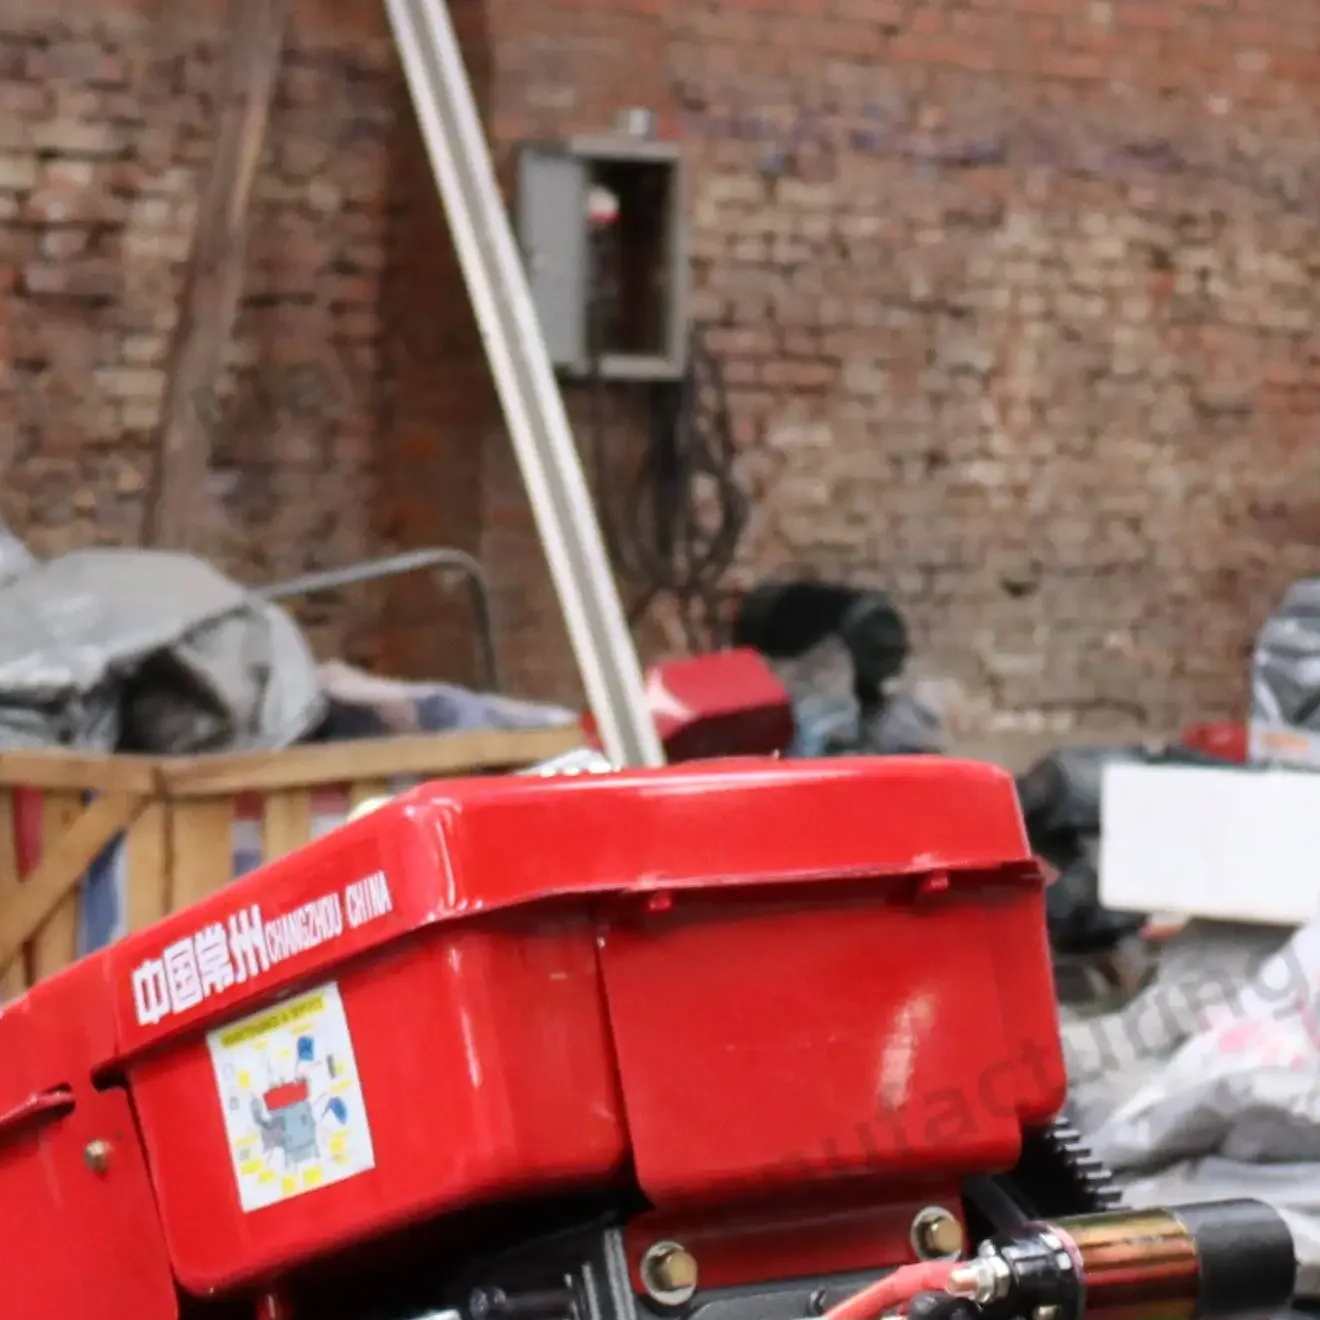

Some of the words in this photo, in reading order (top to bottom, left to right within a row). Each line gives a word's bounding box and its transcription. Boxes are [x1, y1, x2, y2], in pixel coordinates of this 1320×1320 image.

[133, 903, 270, 1025] 中国常州
[266, 893, 342, 962] CHANGZHOU
[345, 871, 392, 929] CHINA
